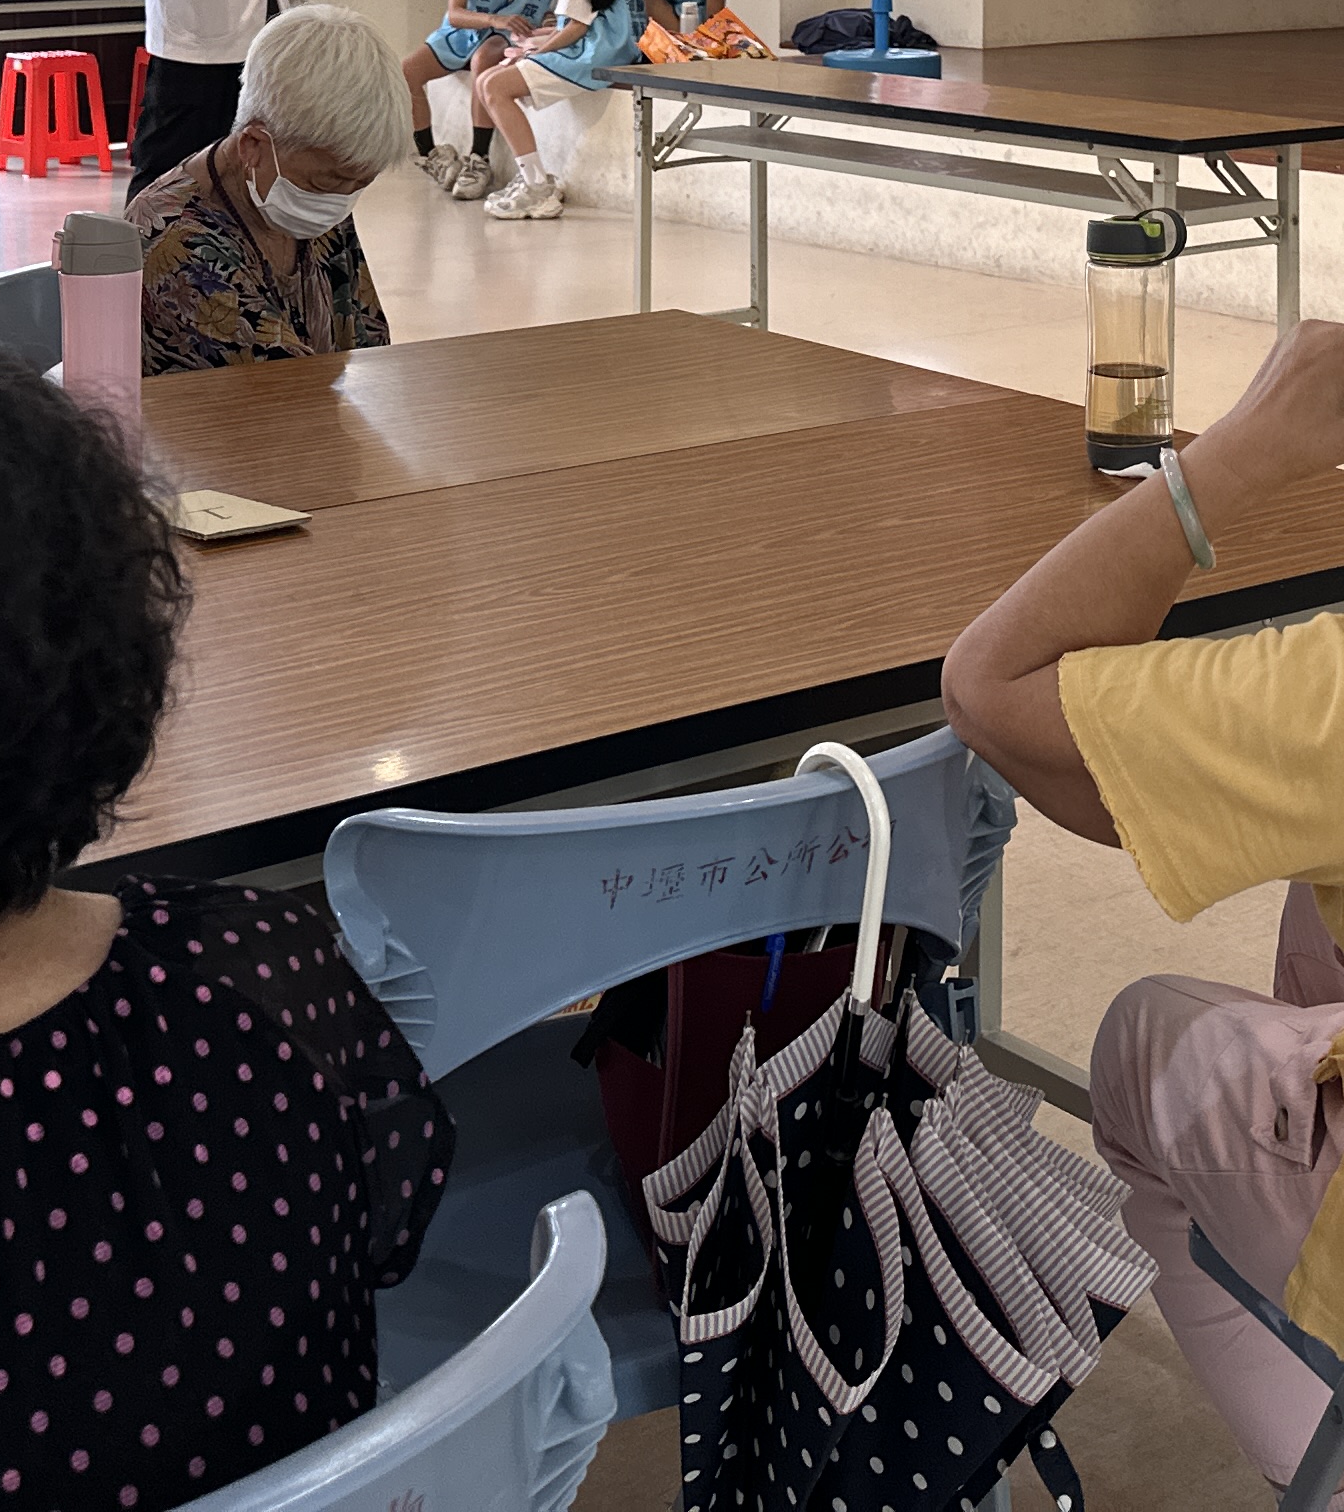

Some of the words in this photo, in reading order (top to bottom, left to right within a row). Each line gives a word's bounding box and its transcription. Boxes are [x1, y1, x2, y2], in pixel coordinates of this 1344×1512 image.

[602, 819, 896, 910] 中壢市公所公
